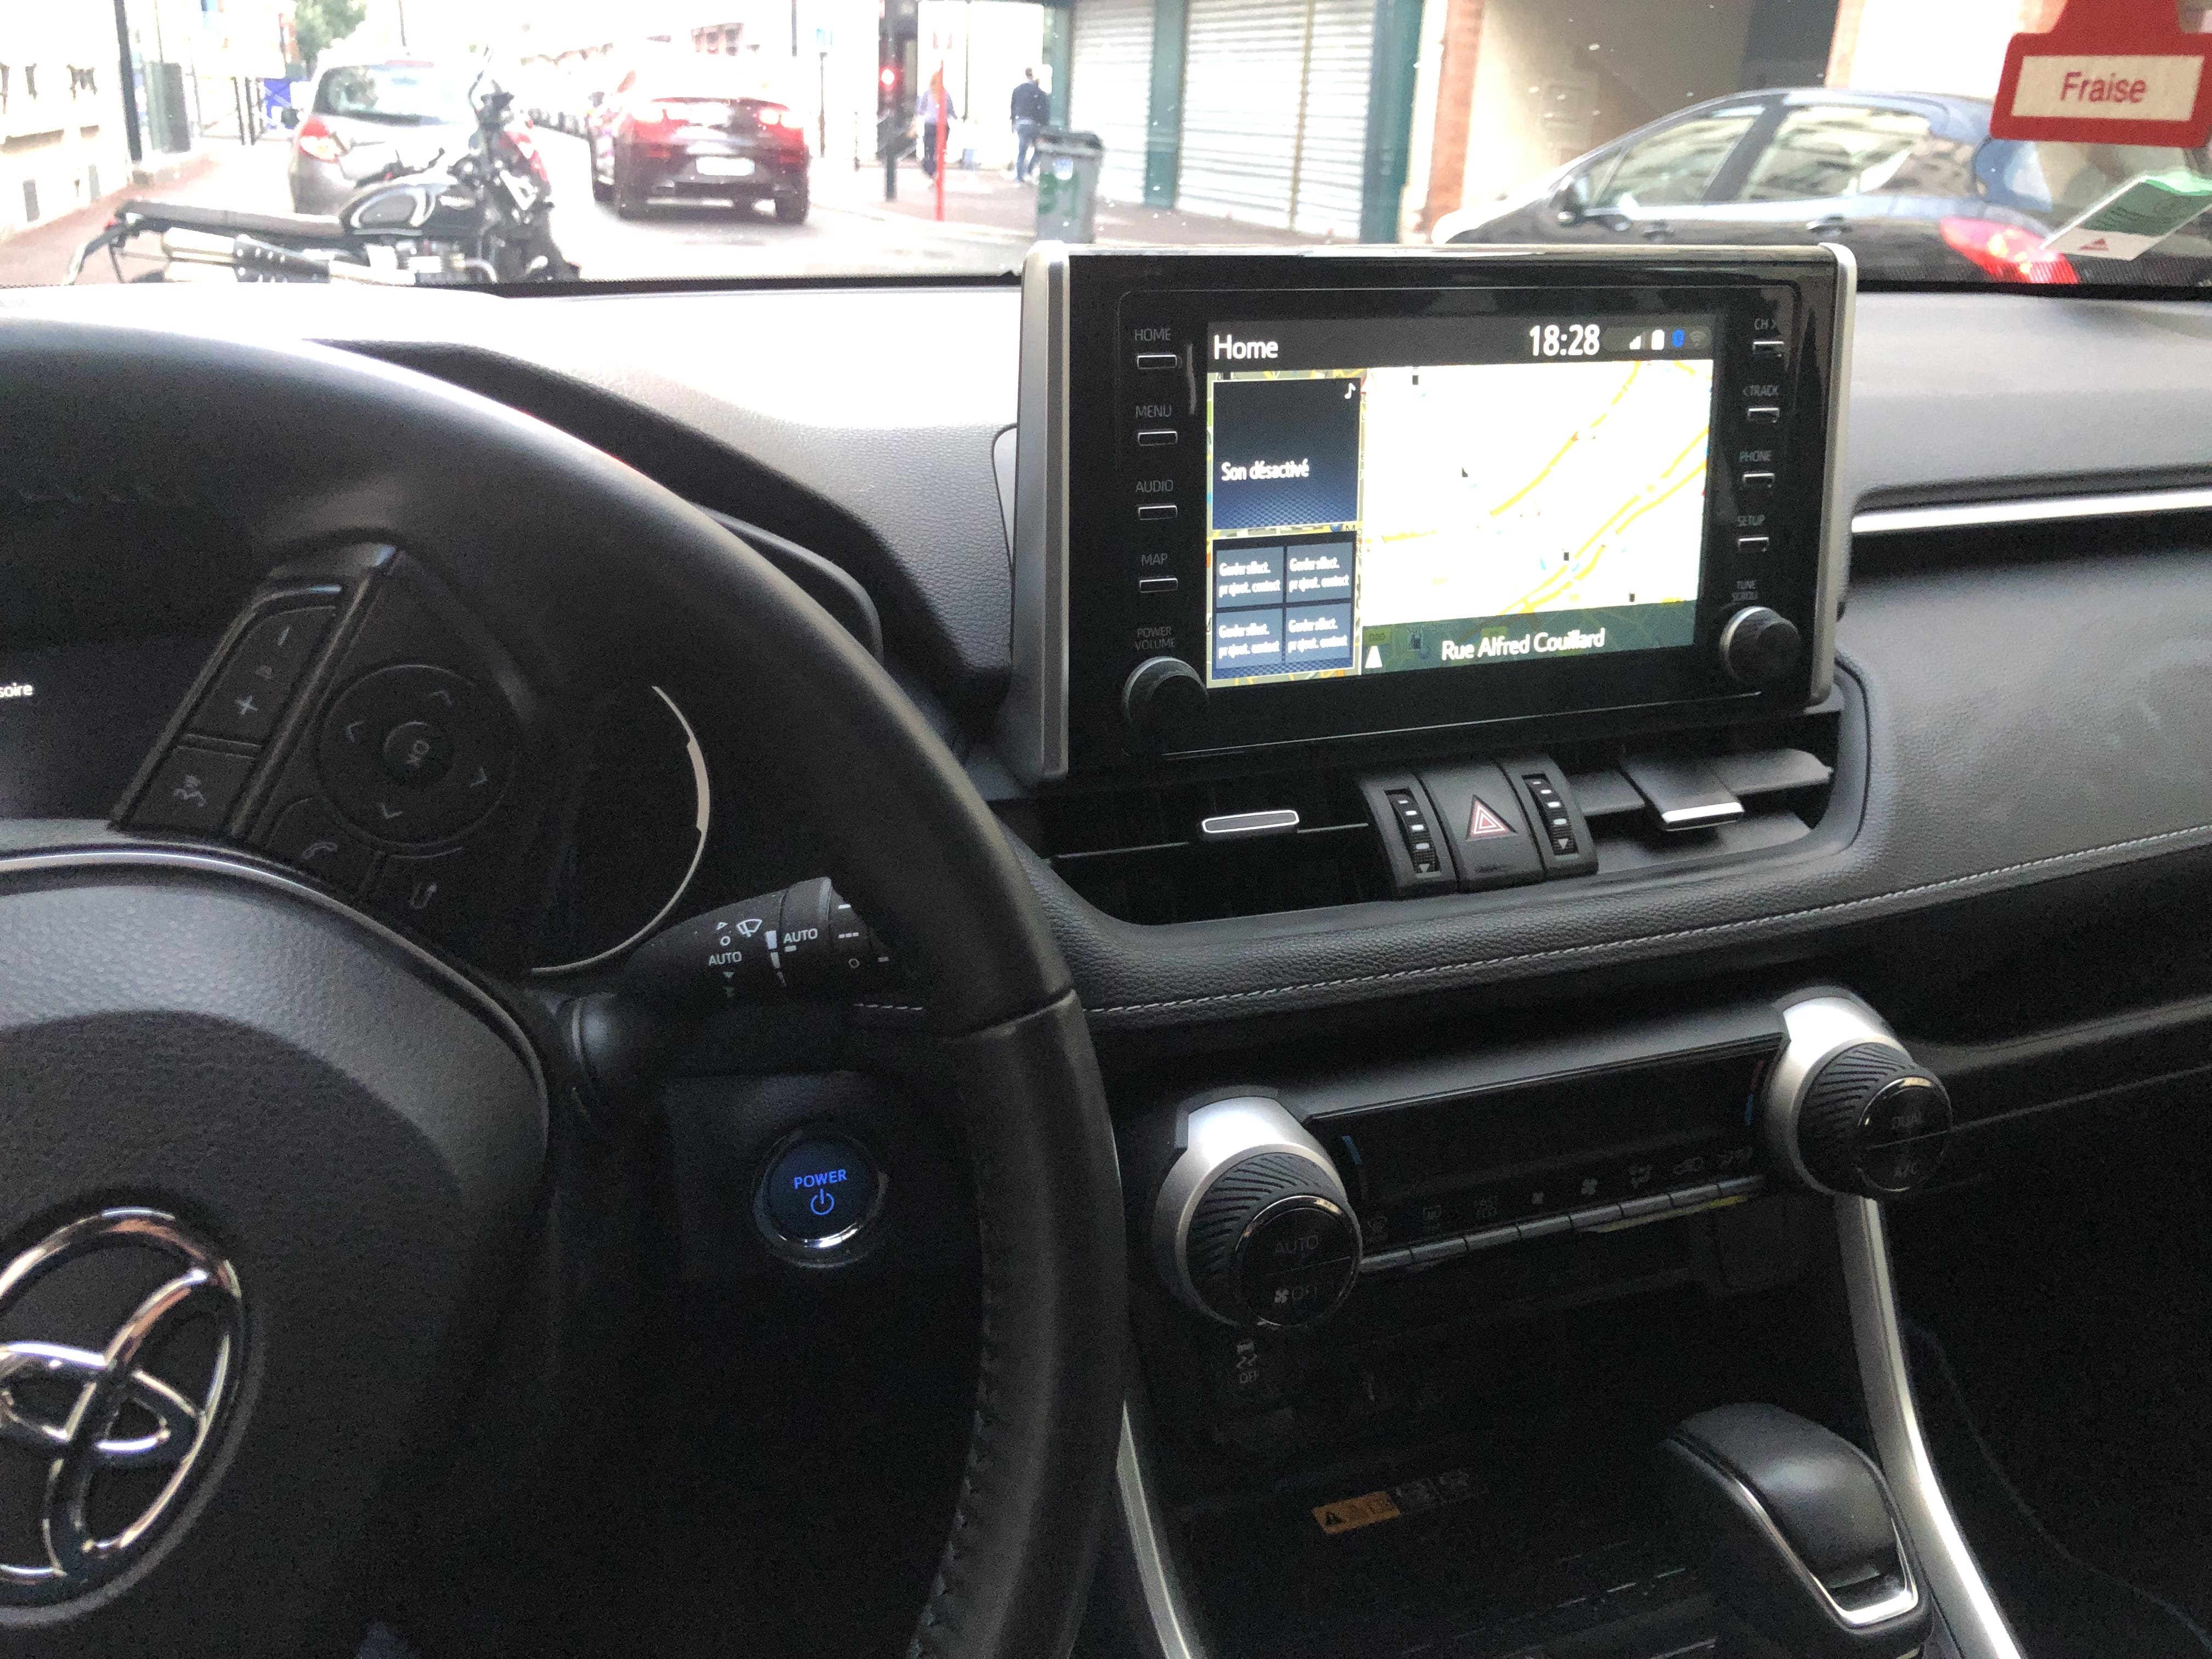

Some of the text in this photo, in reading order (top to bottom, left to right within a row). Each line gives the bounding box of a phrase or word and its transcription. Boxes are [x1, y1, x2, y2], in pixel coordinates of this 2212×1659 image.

[2060, 71, 2147, 103] Fraise
[1134, 328, 1171, 342] HOME
[1529, 324, 1600, 356] 18:28
[1214, 334, 1279, 360] Home
[1135, 404, 1172, 419] MENU
[1739, 450, 1772, 462] PHONE
[1221, 458, 1310, 482] Son désactivé
[1135, 479, 1174, 493] AUDIO
[1141, 552, 1169, 566] MAP
[1137, 626, 1172, 638] POWER
[1135, 637, 1176, 652] VOLUME
[1441, 640, 1476, 662] Rue
[1477, 633, 1531, 659] Alfred
[783, 928, 819, 945] AUTO
[708, 951, 743, 967] AUTO
[793, 1169, 848, 1189] POWER
[1274, 1234, 1320, 1255] AUTO
